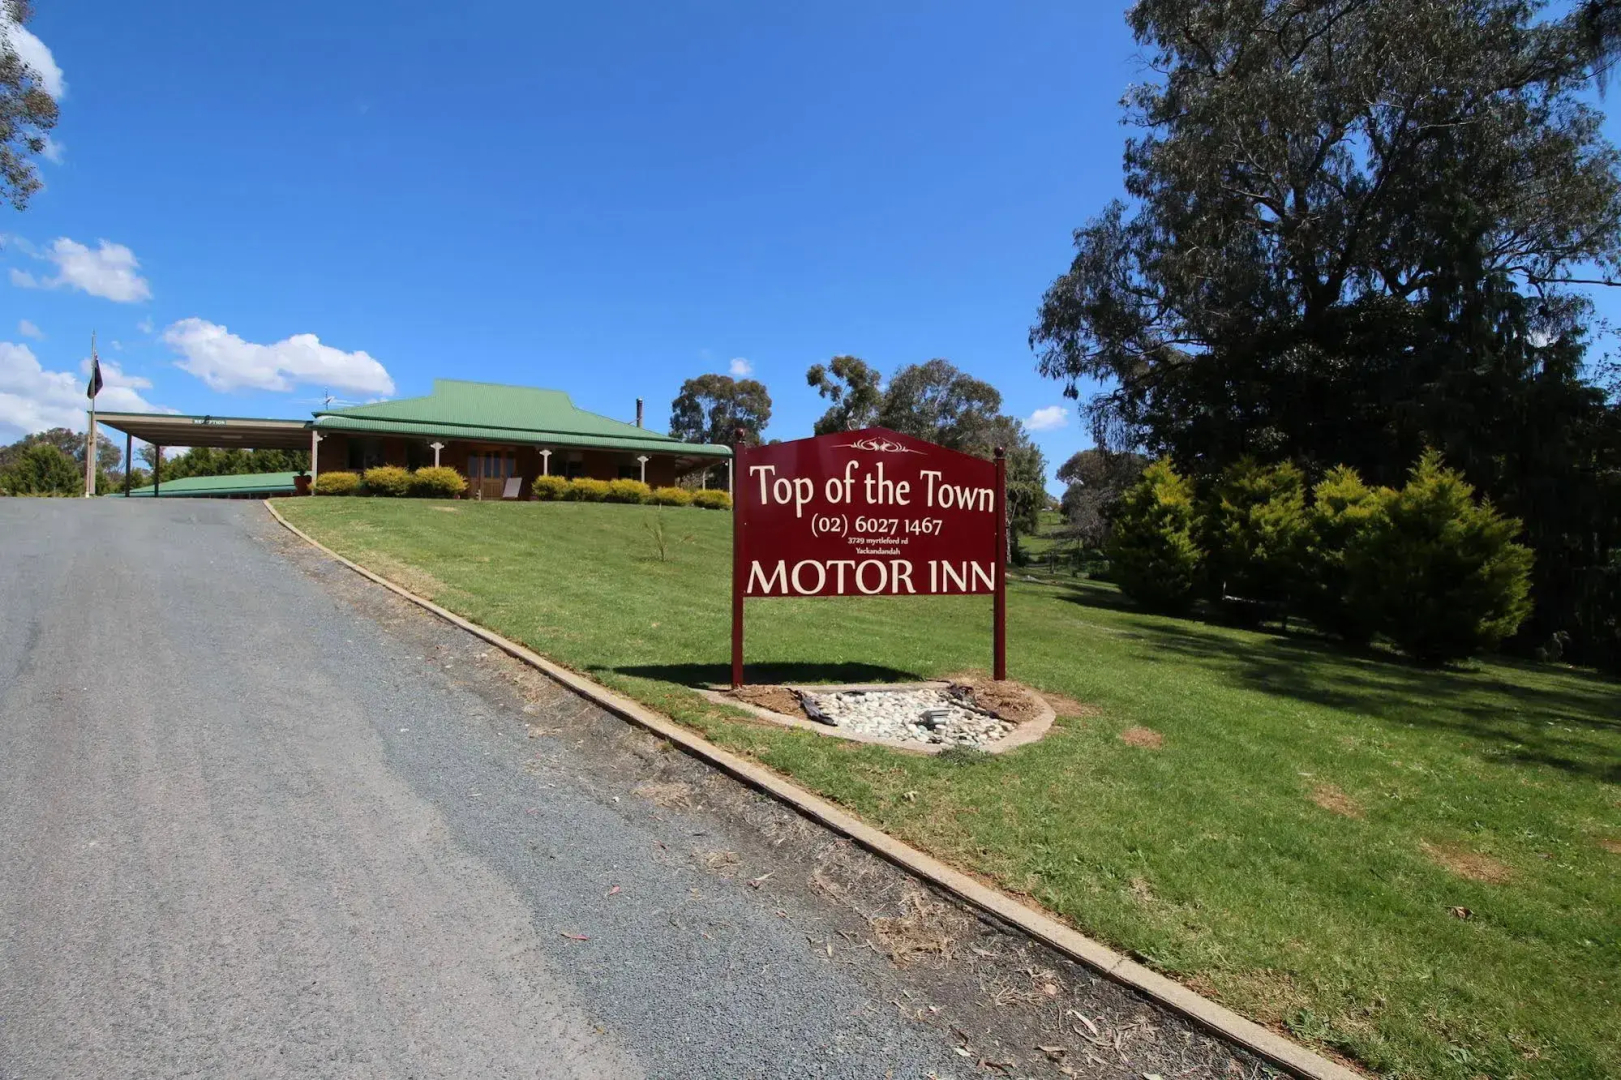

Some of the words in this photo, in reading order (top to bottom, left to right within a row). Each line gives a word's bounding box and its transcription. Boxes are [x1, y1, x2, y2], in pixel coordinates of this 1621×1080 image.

[749, 465, 813, 518] Top
[824, 460, 860, 504] of
[863, 462, 911, 505] the
[919, 469, 994, 513] Town
[811, 513, 849, 538] (02)
[855, 515, 899, 536] 6027
[904, 517, 943, 536] 1467
[855, 547, 901, 555] Yackandandah
[866, 537, 900, 546] myrtleford
[901, 537, 909, 545] rd
[747, 560, 916, 594] MOTOR
[928, 560, 995, 593] INN
